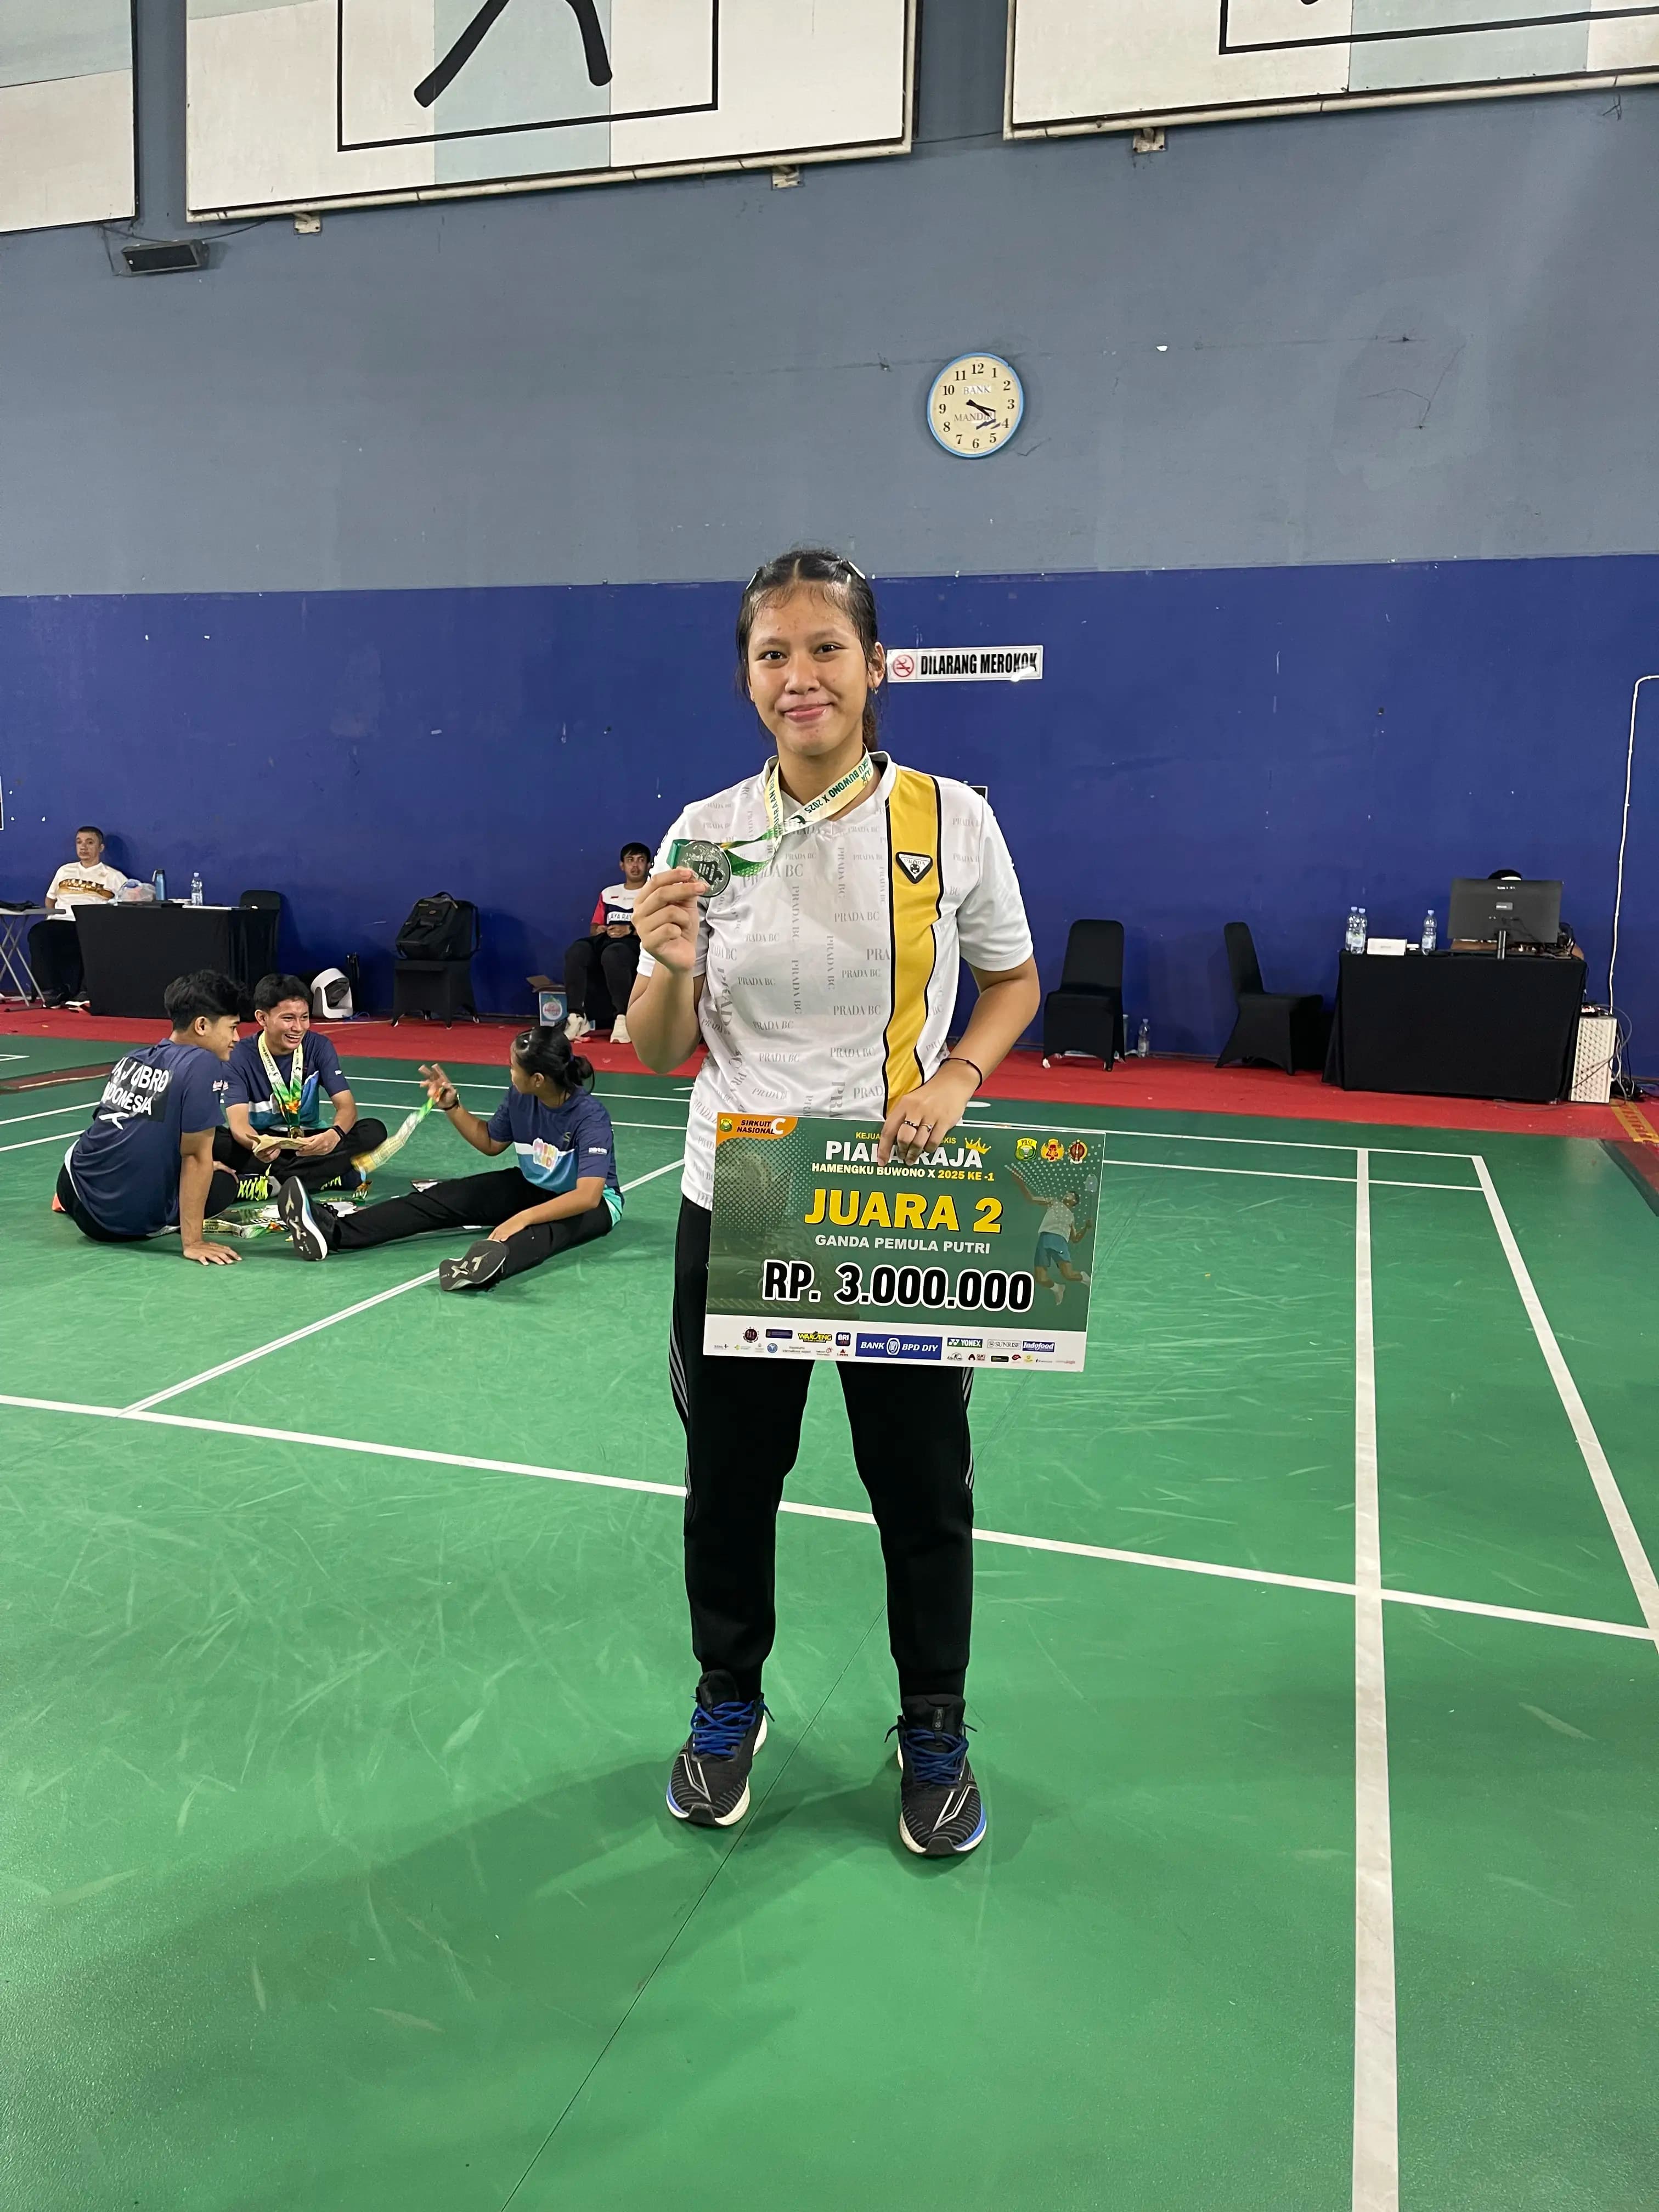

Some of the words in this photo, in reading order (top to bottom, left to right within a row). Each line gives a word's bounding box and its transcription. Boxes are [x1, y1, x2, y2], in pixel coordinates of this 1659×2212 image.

[972, 363, 984, 374] 12
[992, 368, 997, 378] 1
[954, 370, 966, 381] 11
[943, 385, 955, 396] 10
[963, 386, 991, 394] BANK
[1003, 380, 1011, 391] 2
[939, 403, 946, 414] 9
[1007, 399, 1014, 409] 3
[943, 421, 950, 432] 8
[1001, 418, 1009, 428] 4
[956, 434, 962, 444] 7
[972, 438, 979, 449] 6
[989, 433, 996, 443] 5
[921, 654, 977, 675] DILARANG
[980, 652, 1037, 674] MEROKOK
[829, 770, 860, 798] BUWONO
[822, 794, 830, 804] X
[804, 799, 823, 813] 2025
[786, 864, 804, 877] BC
[834, 912, 864, 922] PRADA
[867, 911, 879, 921] BC
[746, 934, 766, 942] RADA
[842, 969, 868, 978] PRADA
[738, 977, 763, 986] PRADA
[833, 1005, 865, 1015] PRADA
[868, 1005, 881, 1015] BC
[831, 1048, 861, 1058] PRADA
[770, 1118, 786, 1135] C
[856, 1132, 881, 1140] KEJUA
[812, 1163, 873, 1175] HAMENGKU
[877, 1166, 926, 1178] BUWONO
[927, 1169, 935, 1178] X
[938, 1170, 964, 1180] 2025
[967, 1171, 982, 1181] KE
[984, 1172, 995, 1181] -1
[804, 1188, 961, 1232] JUARA
[973, 1197, 1003, 1234] 2
[815, 1234, 870, 1249] GANDA
[874, 1237, 939, 1252] PEMULA
[943, 1240, 991, 1255] PUTRI
[763, 1259, 821, 1302] RP.
[833, 1262, 1035, 1313] 3.000.000
[860, 1341, 885, 1350] BANK
[961, 1339, 981, 1347] YONEX
[1023, 1341, 1054, 1351] Indofood
